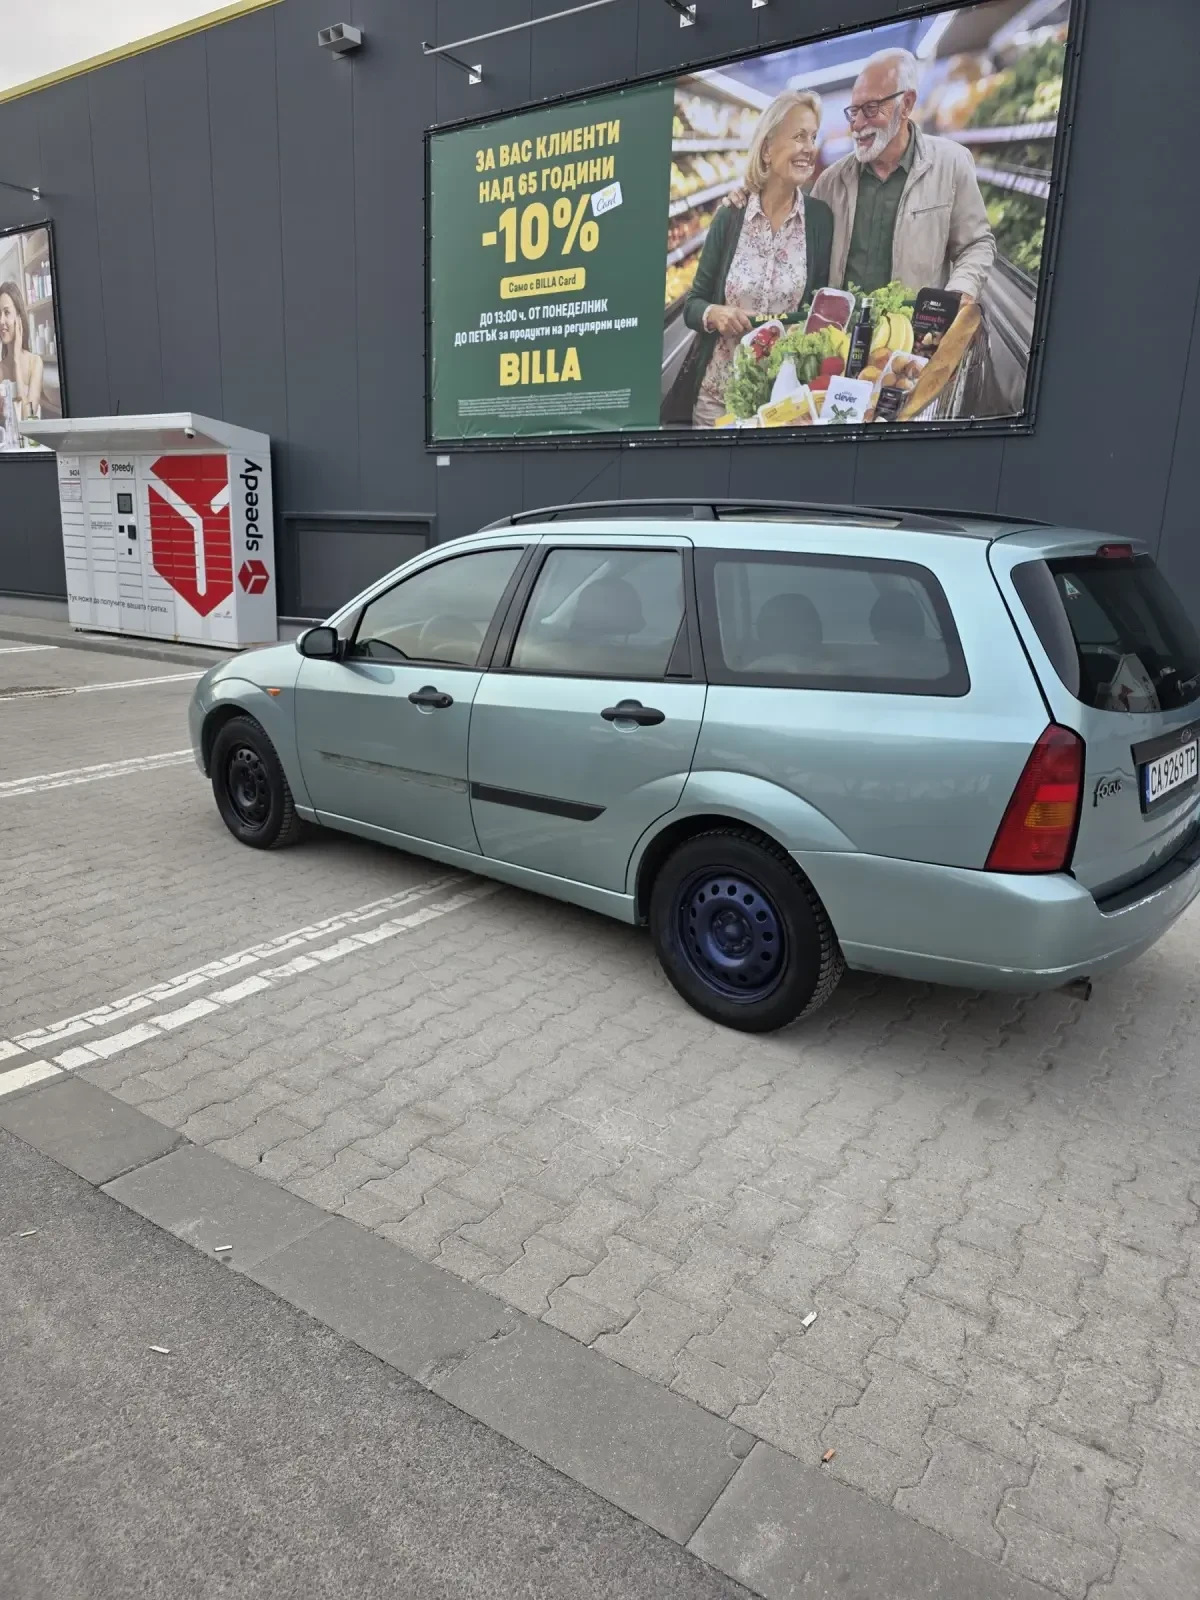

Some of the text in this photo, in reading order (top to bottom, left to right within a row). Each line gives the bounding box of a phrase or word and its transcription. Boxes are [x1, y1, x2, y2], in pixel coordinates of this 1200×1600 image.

[475, 119, 621, 172] ЗА ВАС КЛИЕНТИ
[479, 155, 615, 203] НАД 65 ГОДИНИ
[482, 193, 600, 263] -10%
[508, 281, 528, 293] Само
[535, 276, 557, 289] BILLA
[558, 273, 577, 287] Card
[479, 298, 609, 328] ДО 13:00 ч. ОТ ПОНЕДЕЛНИК
[454, 317, 638, 347] ДО ПЕТЪК за продукти на регулярни цени
[499, 347, 582, 386] BILLA
[834, 392, 857, 403] clever
[111, 461, 134, 475] speedy
[239, 458, 263, 551] speedy
[68, 593, 77, 602] Тук
